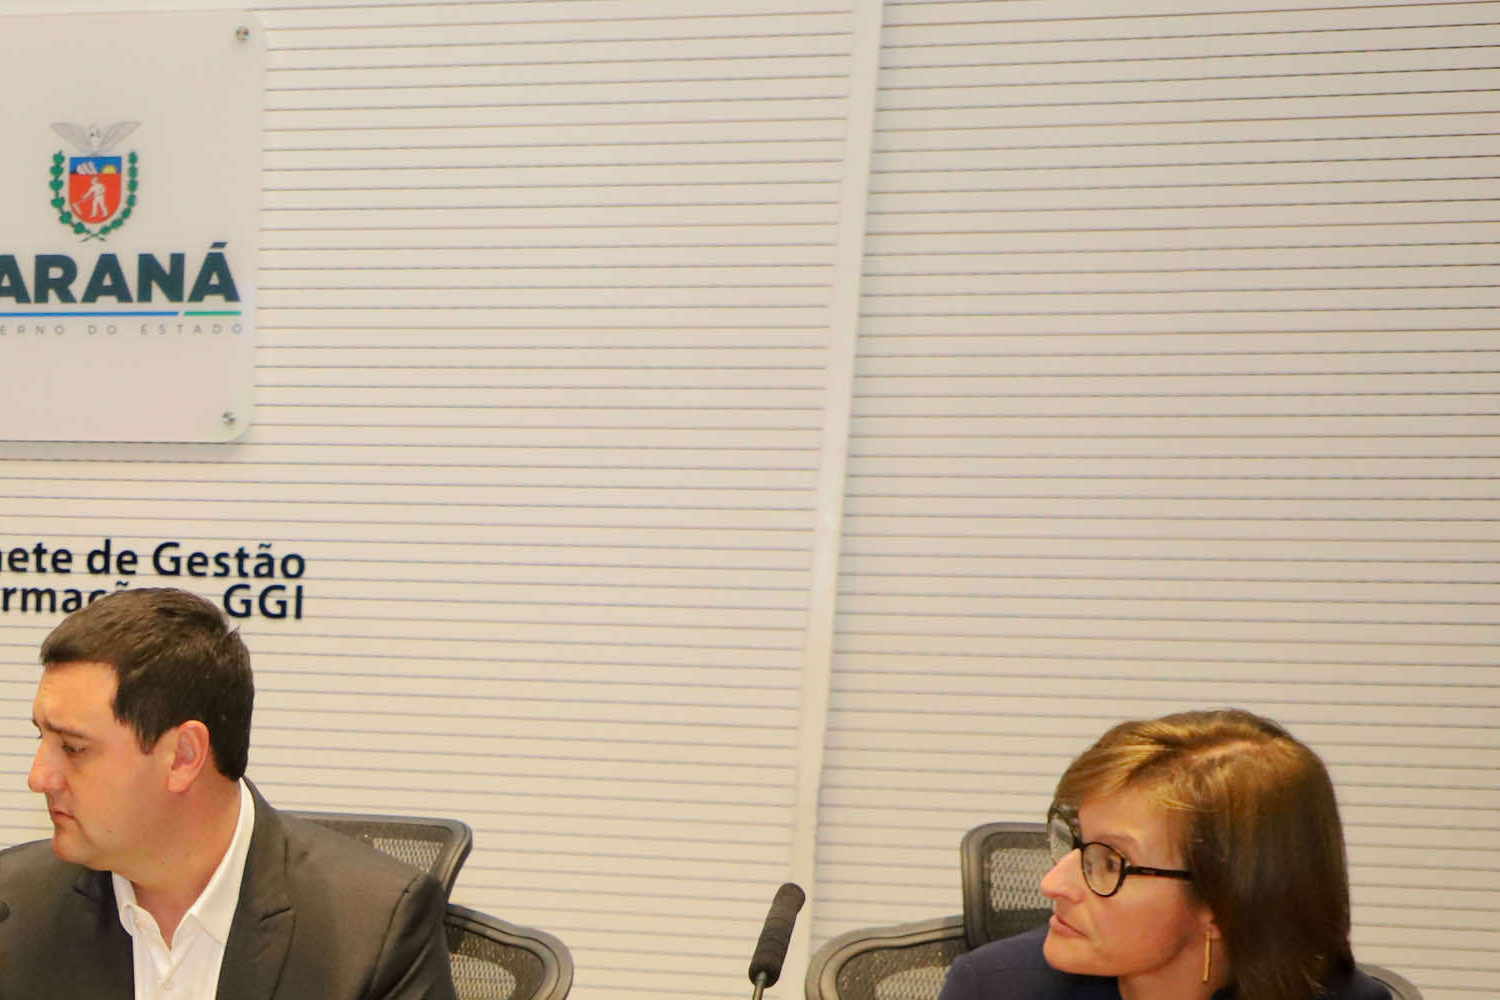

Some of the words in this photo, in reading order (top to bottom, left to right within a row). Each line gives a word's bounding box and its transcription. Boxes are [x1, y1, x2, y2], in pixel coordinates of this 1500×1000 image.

[88, 324, 117, 335] DO
[141, 323, 243, 335] ESTADO
[86, 539, 139, 576] de
[152, 541, 306, 579] Gestão
[222, 584, 303, 620] GGI
